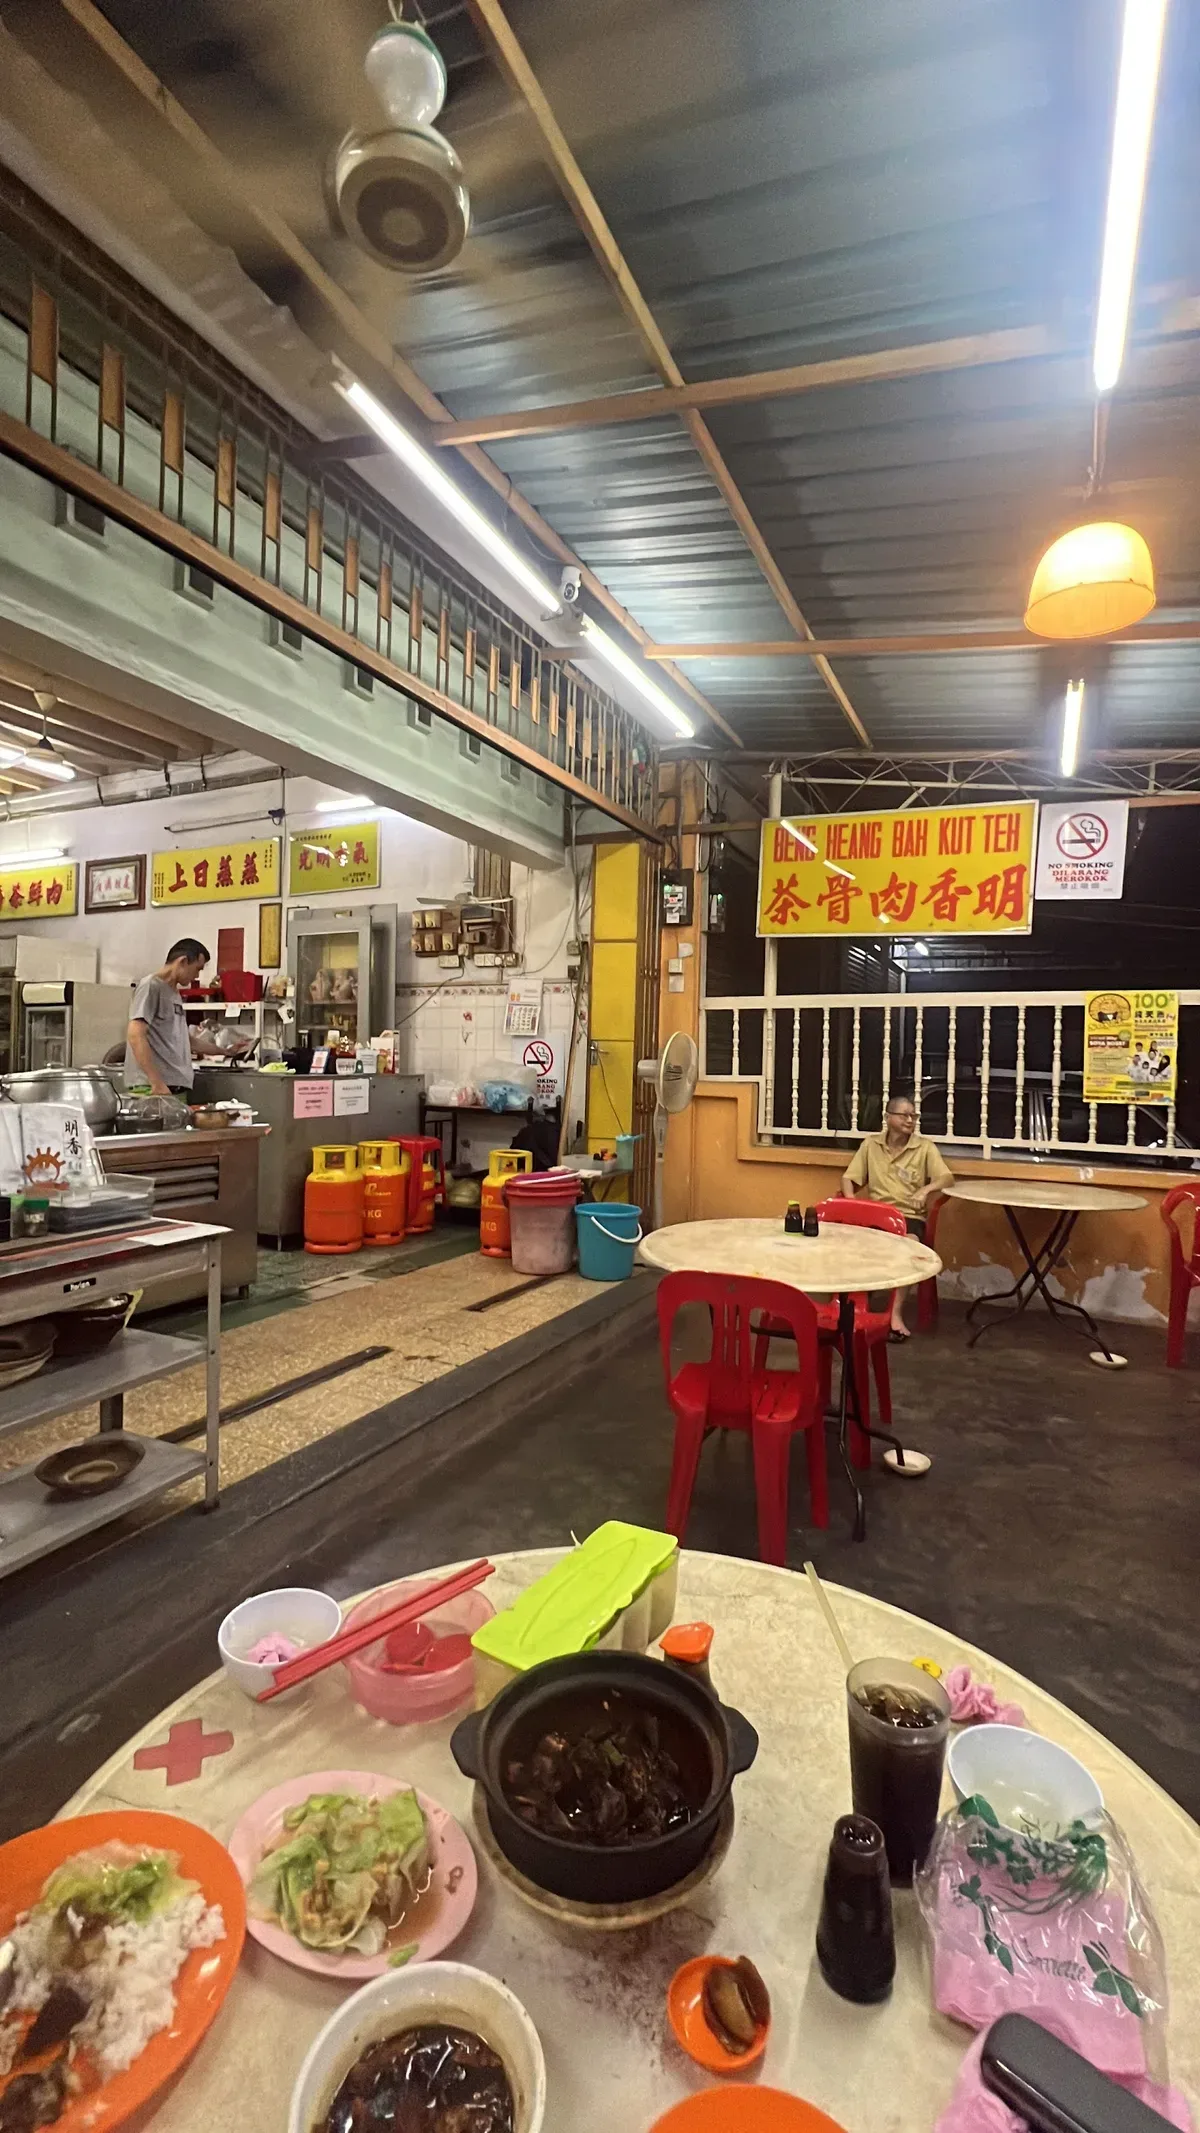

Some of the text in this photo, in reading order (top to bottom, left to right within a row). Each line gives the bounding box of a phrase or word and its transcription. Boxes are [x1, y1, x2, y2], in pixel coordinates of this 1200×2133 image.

[773, 813, 1021, 863] BENG HEANG BAH KUT TEH
[1055, 875, 1108, 883] MEROKOK
